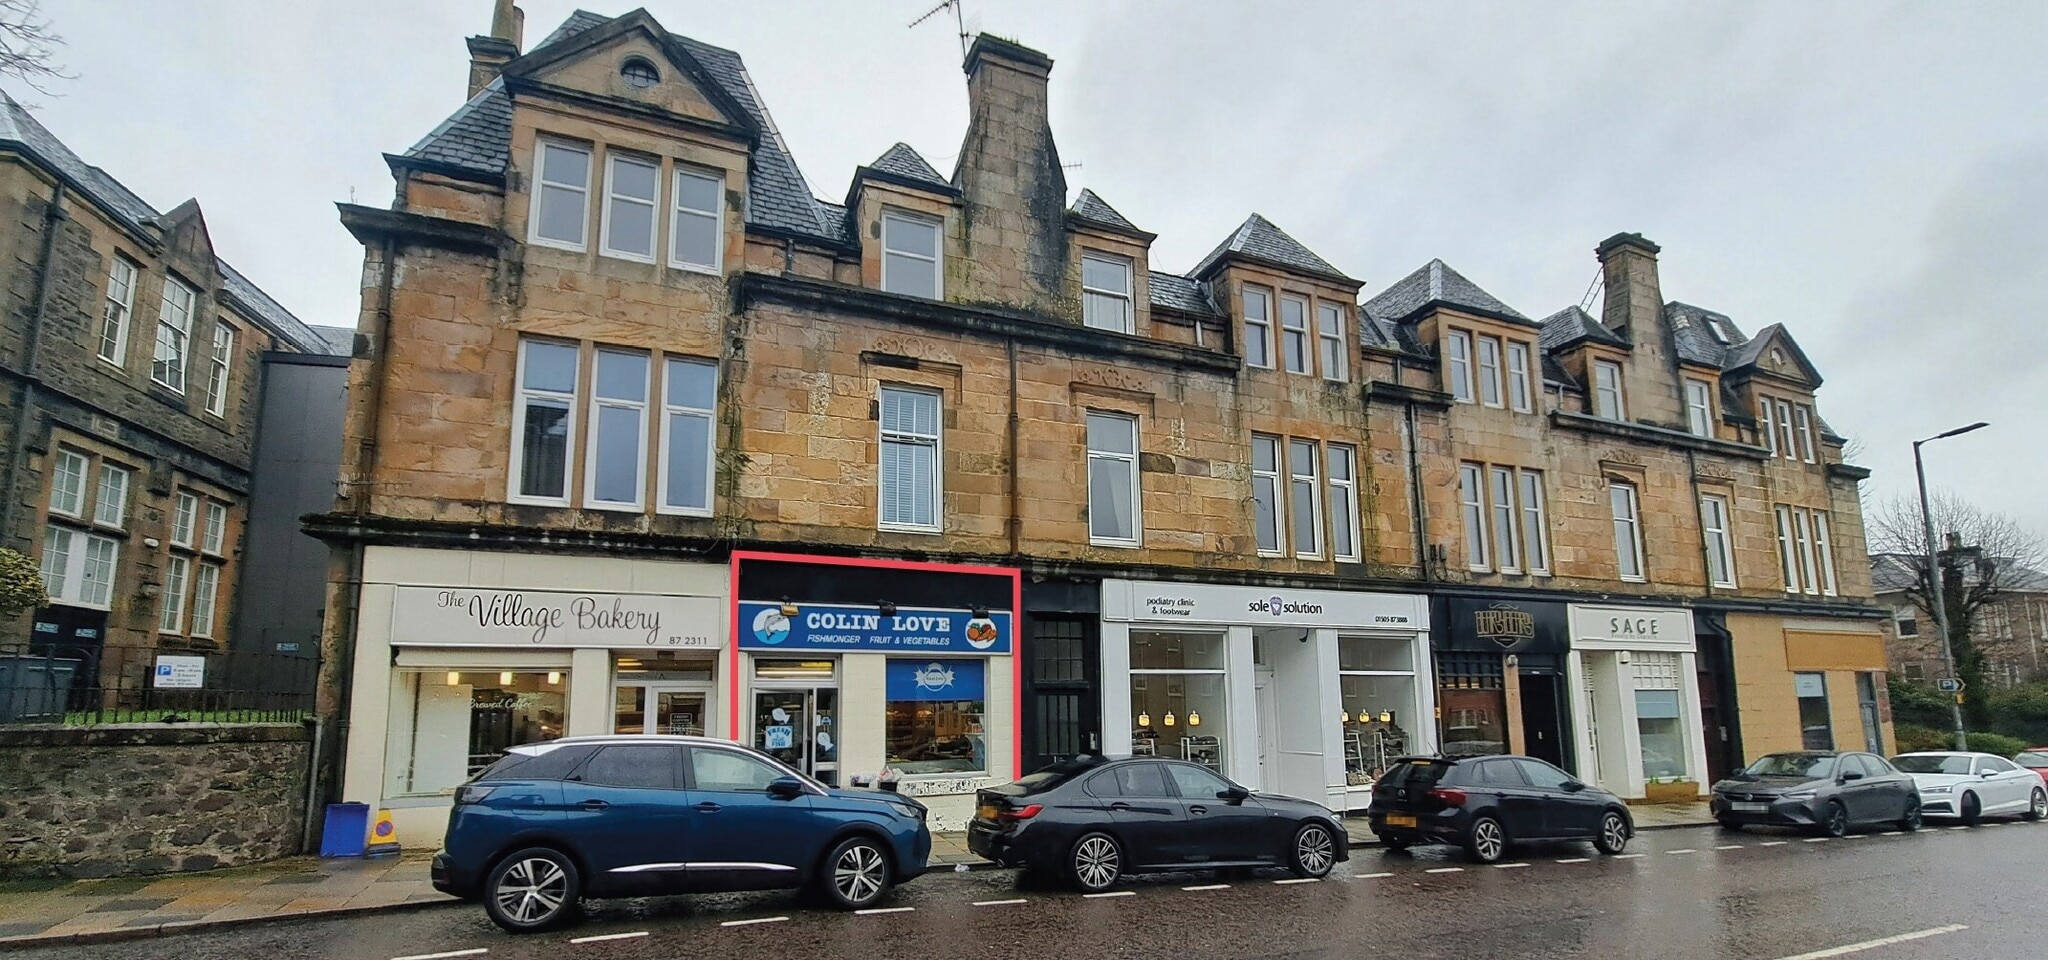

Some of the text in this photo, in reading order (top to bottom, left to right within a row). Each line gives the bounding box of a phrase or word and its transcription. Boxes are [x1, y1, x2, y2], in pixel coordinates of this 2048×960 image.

[1146, 597, 1195, 607] podiatry clinic
[1248, 599, 1323, 614] sole solution
[1151, 606, 1191, 615] & footwear
[437, 591, 662, 645] The Village Bakery
[806, 612, 950, 632] COLIN LOVE
[1610, 617, 1659, 634] SAGE
[669, 636, 708, 645] 87 2311
[807, 634, 950, 646] FISHMONGER FRUIT & VEGETABLES
[469, 698, 533, 710] Brewed Coffee
[767, 727, 791, 736] FRESH
